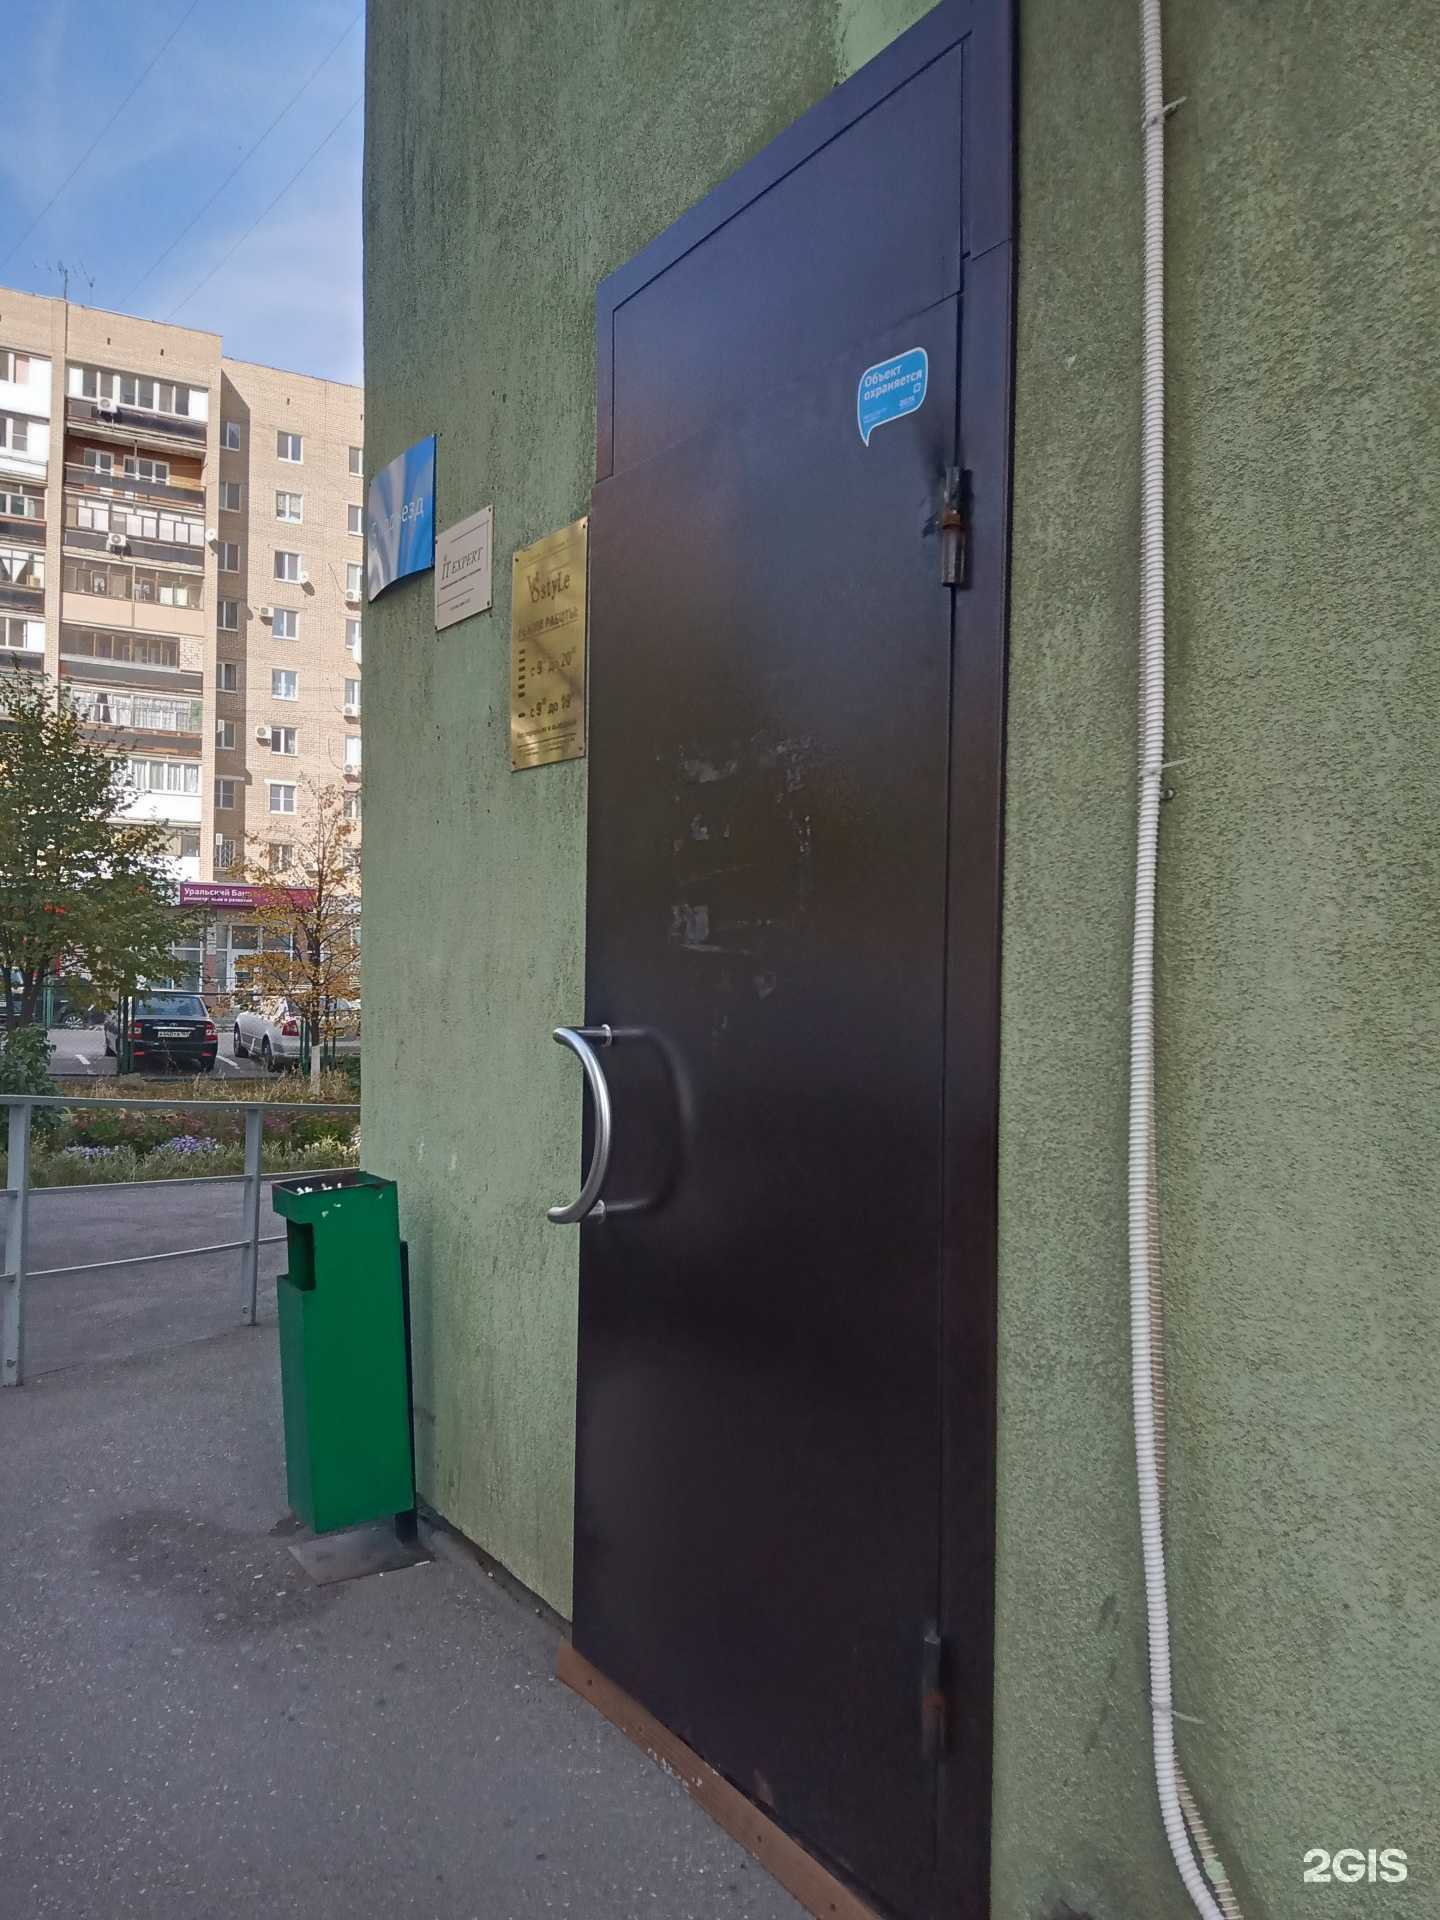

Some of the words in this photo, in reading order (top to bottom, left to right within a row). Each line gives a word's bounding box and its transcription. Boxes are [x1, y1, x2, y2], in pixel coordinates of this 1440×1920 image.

[864, 364, 902, 387] Объект
[864, 370, 922, 400] охраняется
[452, 546, 484, 575] EXPERT
